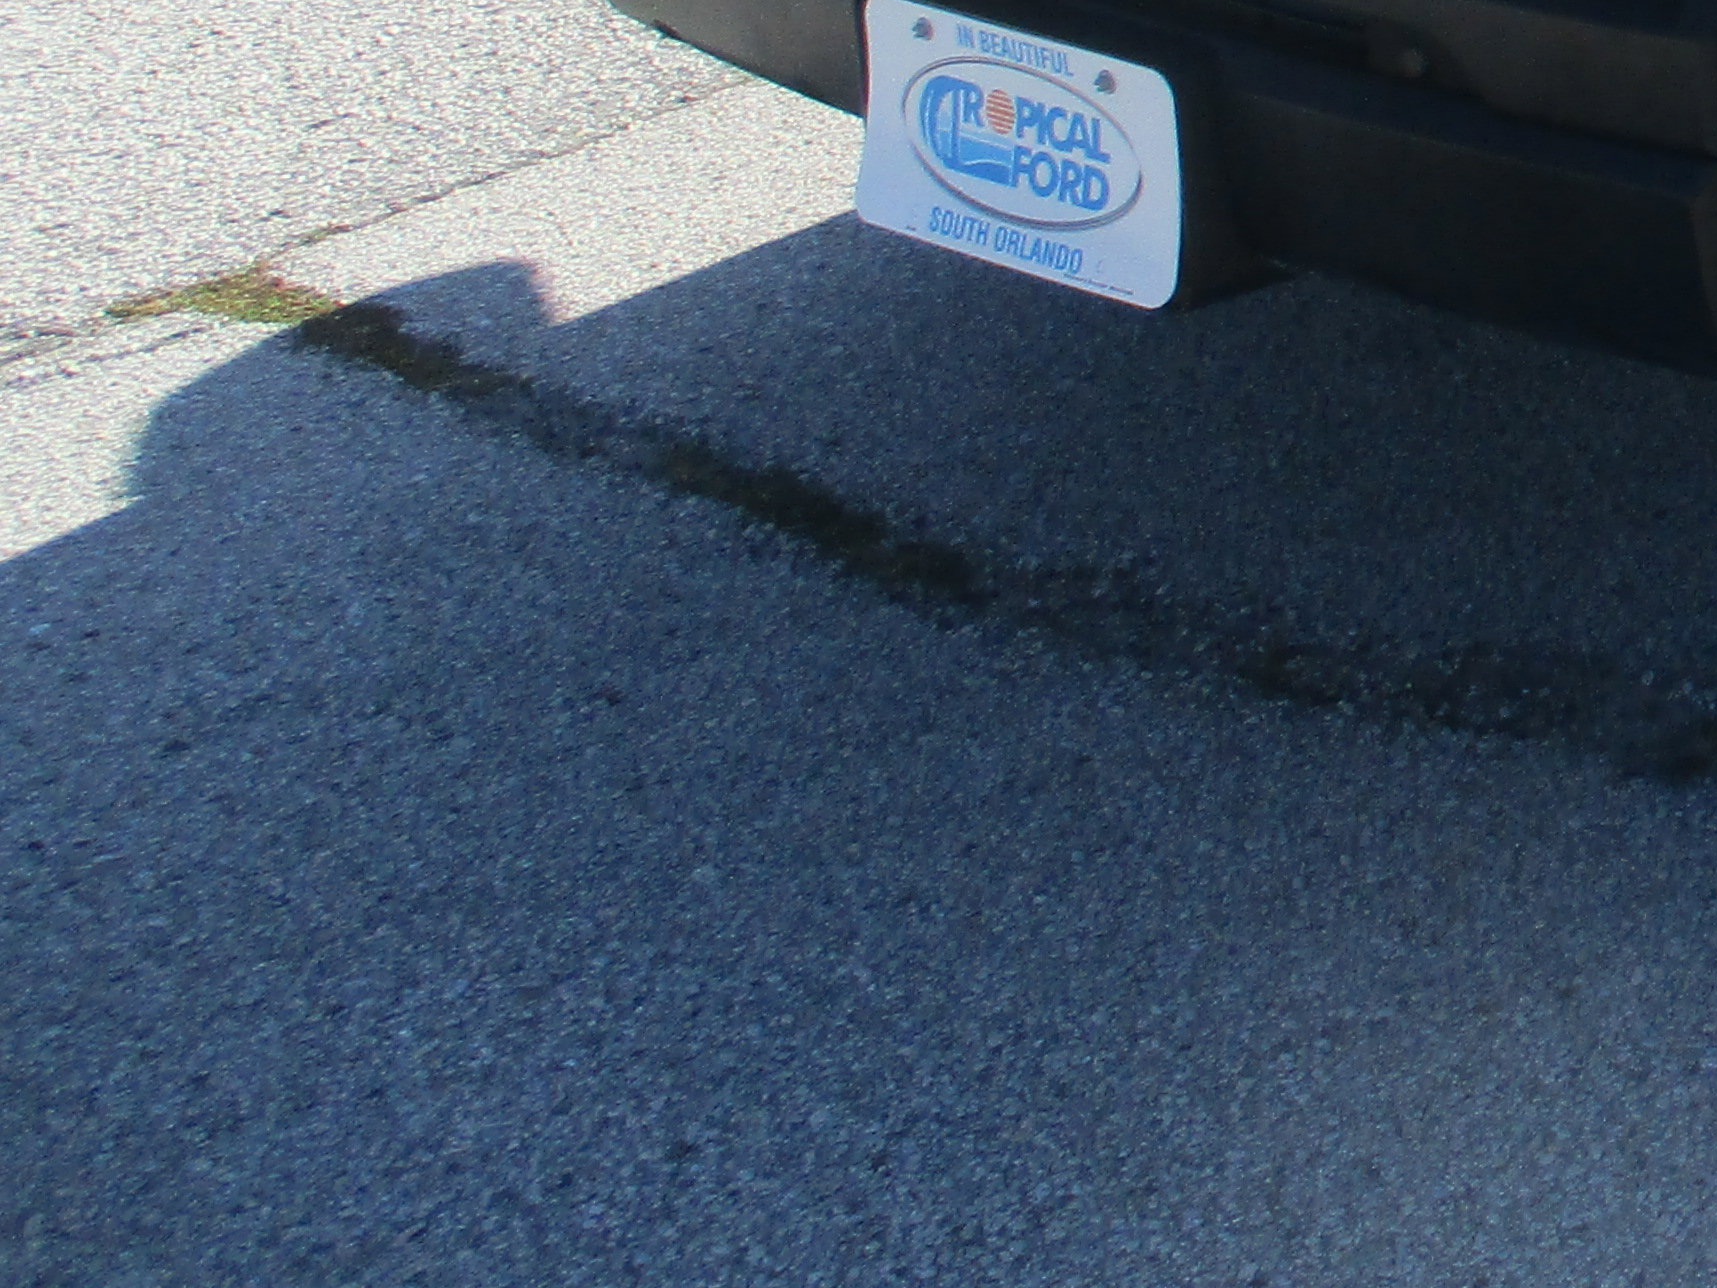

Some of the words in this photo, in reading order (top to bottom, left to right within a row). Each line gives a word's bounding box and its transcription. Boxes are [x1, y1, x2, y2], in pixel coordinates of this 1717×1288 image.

[955, 23, 975, 49] IN
[980, 30, 1074, 78] BEAUTIFUL
[919, 74, 1113, 166] TROPICAL
[1008, 149, 1111, 213] FORD
[928, 206, 991, 247] SOUTH
[993, 226, 1083, 275] ORLANDO
